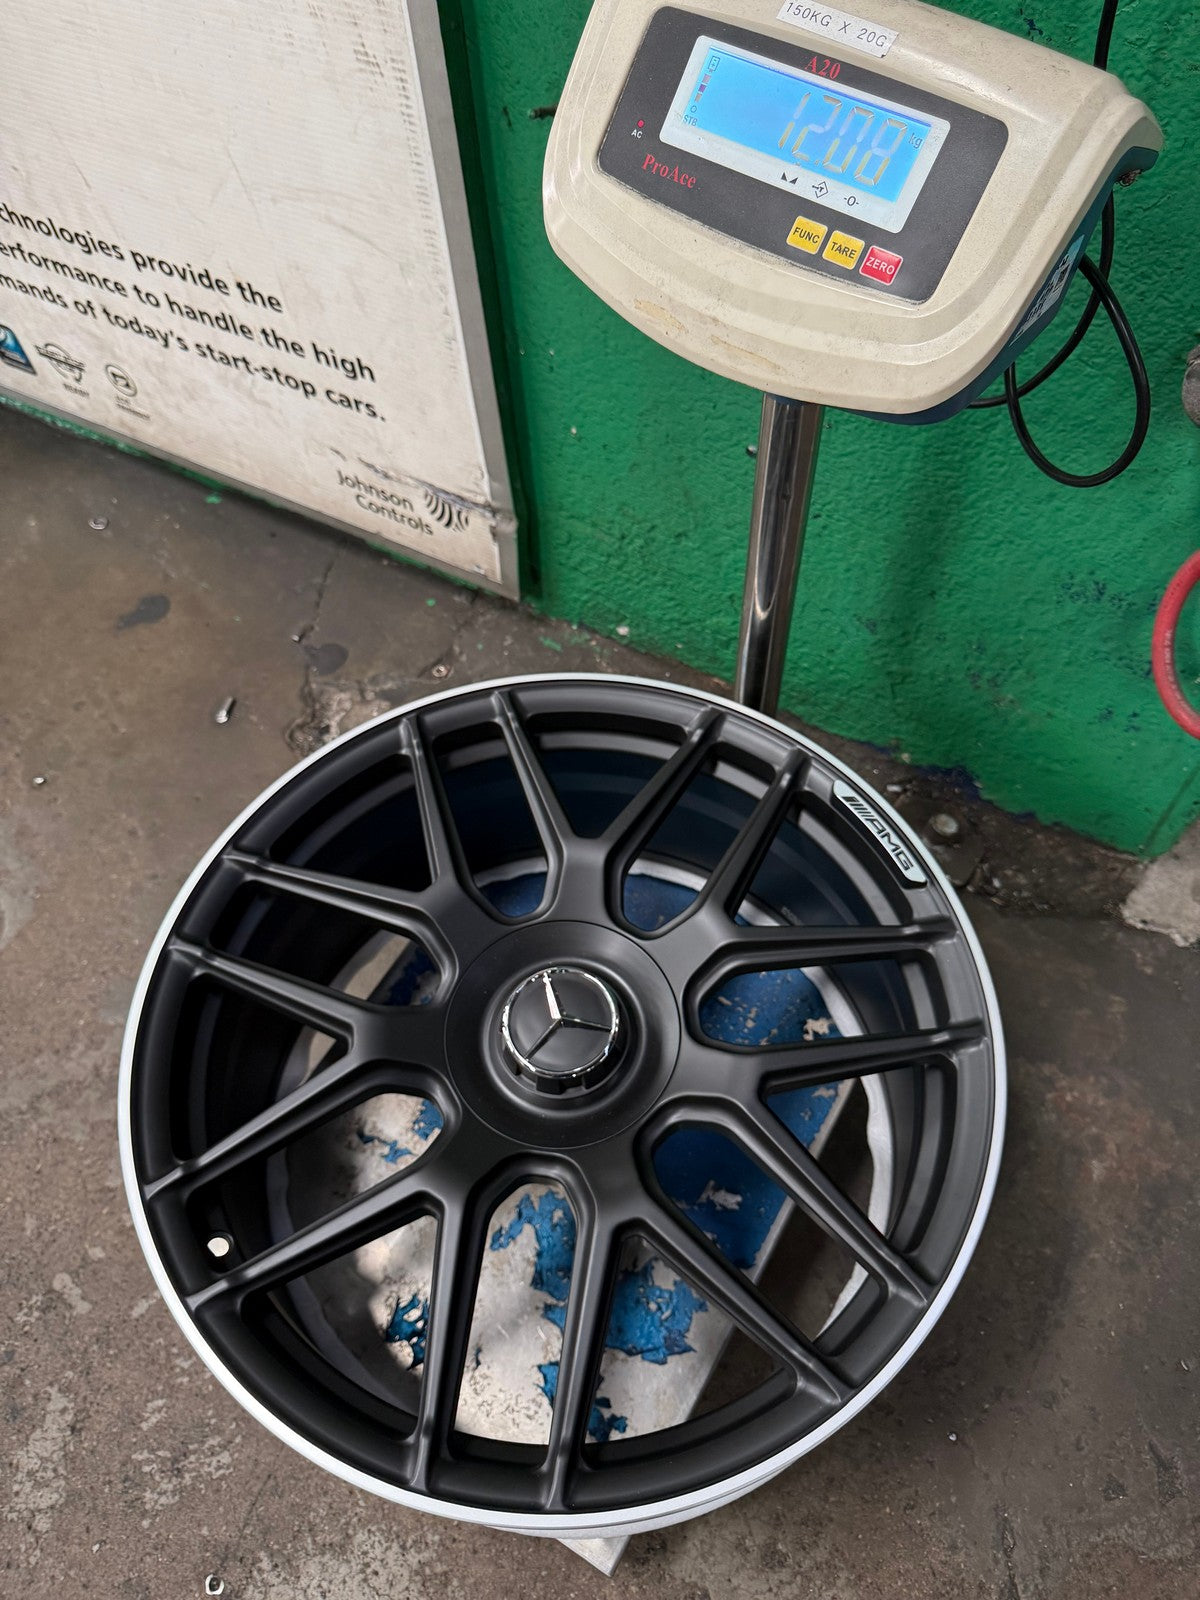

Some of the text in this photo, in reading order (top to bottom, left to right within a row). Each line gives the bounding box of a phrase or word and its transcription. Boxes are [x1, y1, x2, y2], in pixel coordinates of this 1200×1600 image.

[785, 2, 887, 47] 150KG X 20G
[804, 56, 841, 79] A20
[631, 129, 643, 139] AC
[683, 114, 698, 126] STB
[908, 132, 923, 149] kg
[641, 153, 697, 189] ProAce
[793, 227, 820, 244] FUNC
[831, 241, 857, 259] TARE
[866, 256, 895, 275] ZERO
[130, 249, 230, 296] provide
[236, 281, 284, 313] the
[133, 284, 161, 308] to
[165, 293, 254, 340] handle
[260, 327, 305, 358] the
[311, 341, 376, 382] high
[74, 300, 97, 319] of
[101, 305, 189, 351] today's
[195, 342, 317, 400] start-stop
[325, 389, 386, 422] cars.
[336, 468, 415, 512] Johnson
[356, 494, 434, 536] Controls
